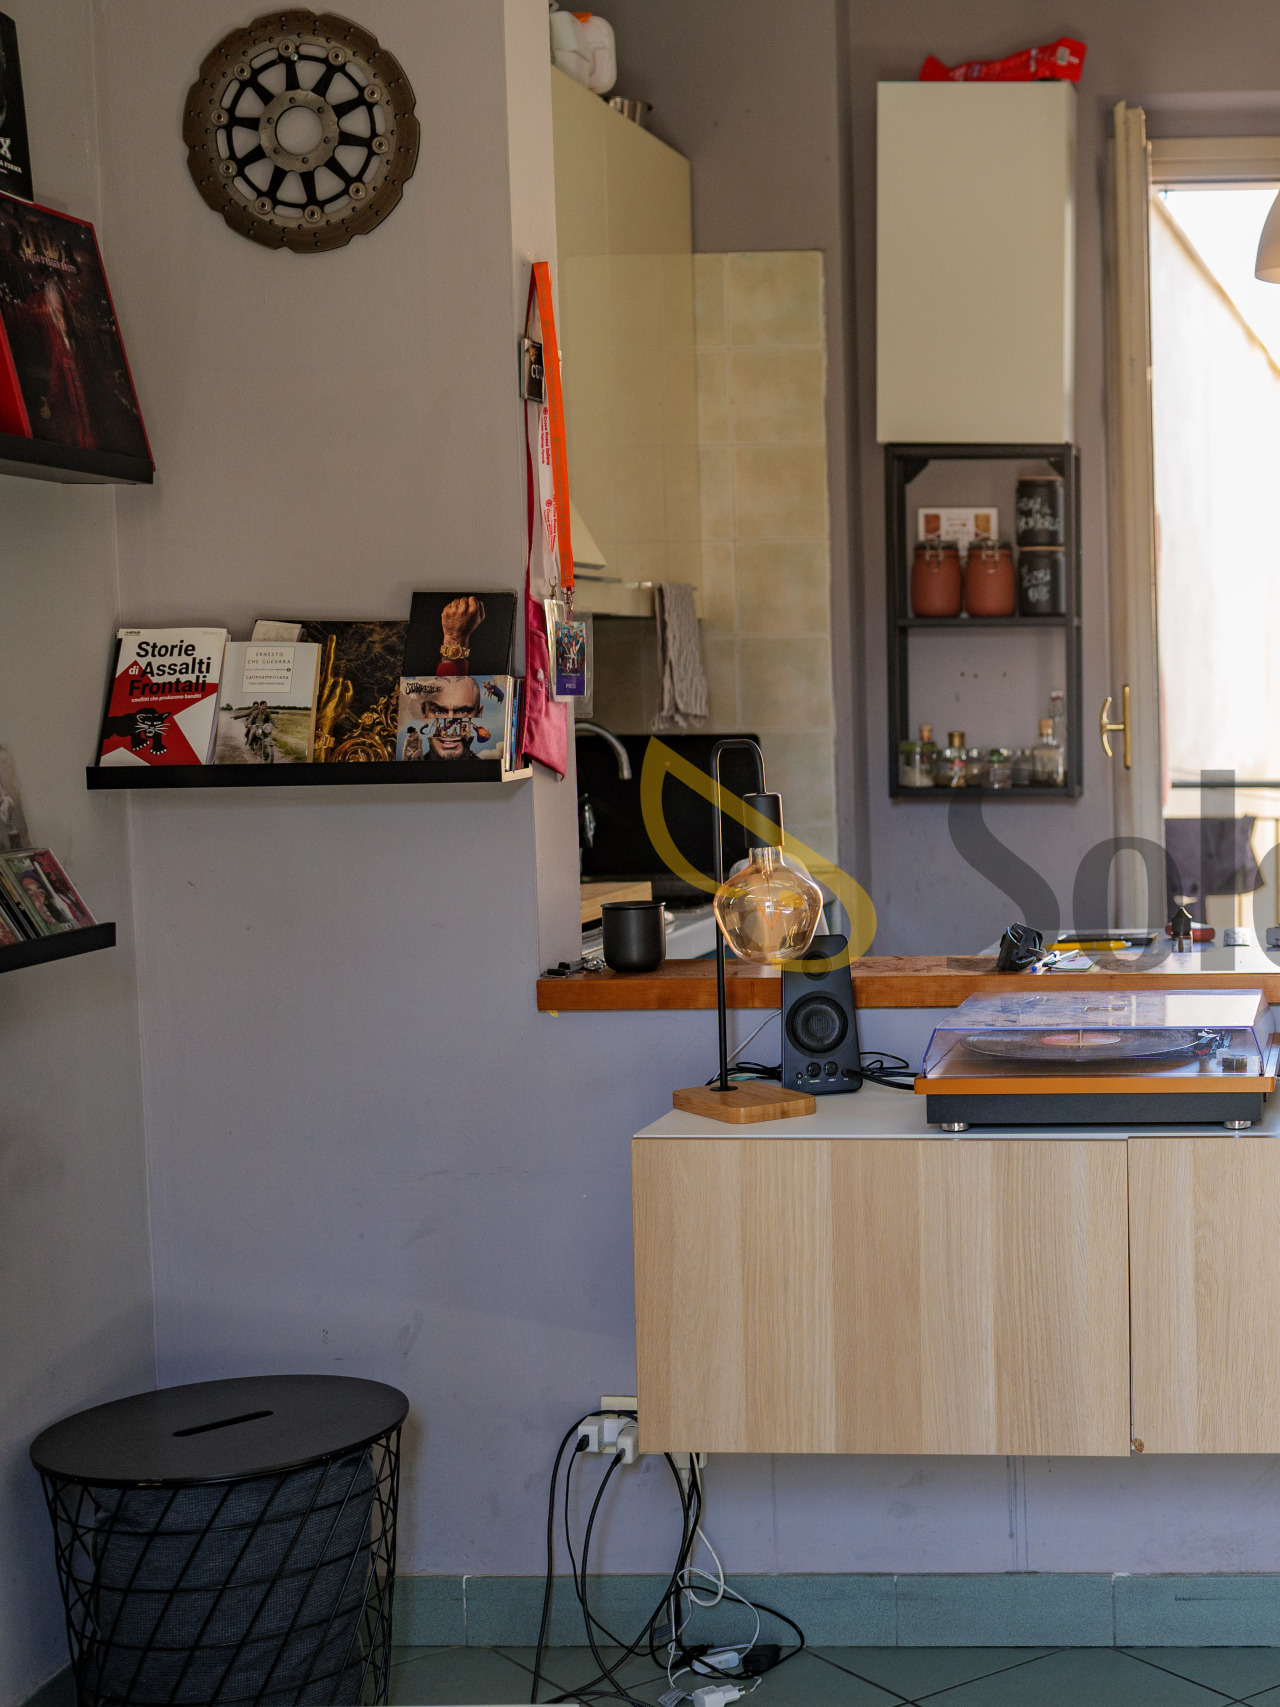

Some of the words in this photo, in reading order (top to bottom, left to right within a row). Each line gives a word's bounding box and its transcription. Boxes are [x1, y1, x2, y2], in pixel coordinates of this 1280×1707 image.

[136, 640, 196, 658] Storie
[129, 665, 139, 675] di
[140, 657, 211, 678] Assalti
[129, 675, 207, 697] Frontali
[405, 682, 441, 696] SURREALE
[159, 694, 184, 702] producono
